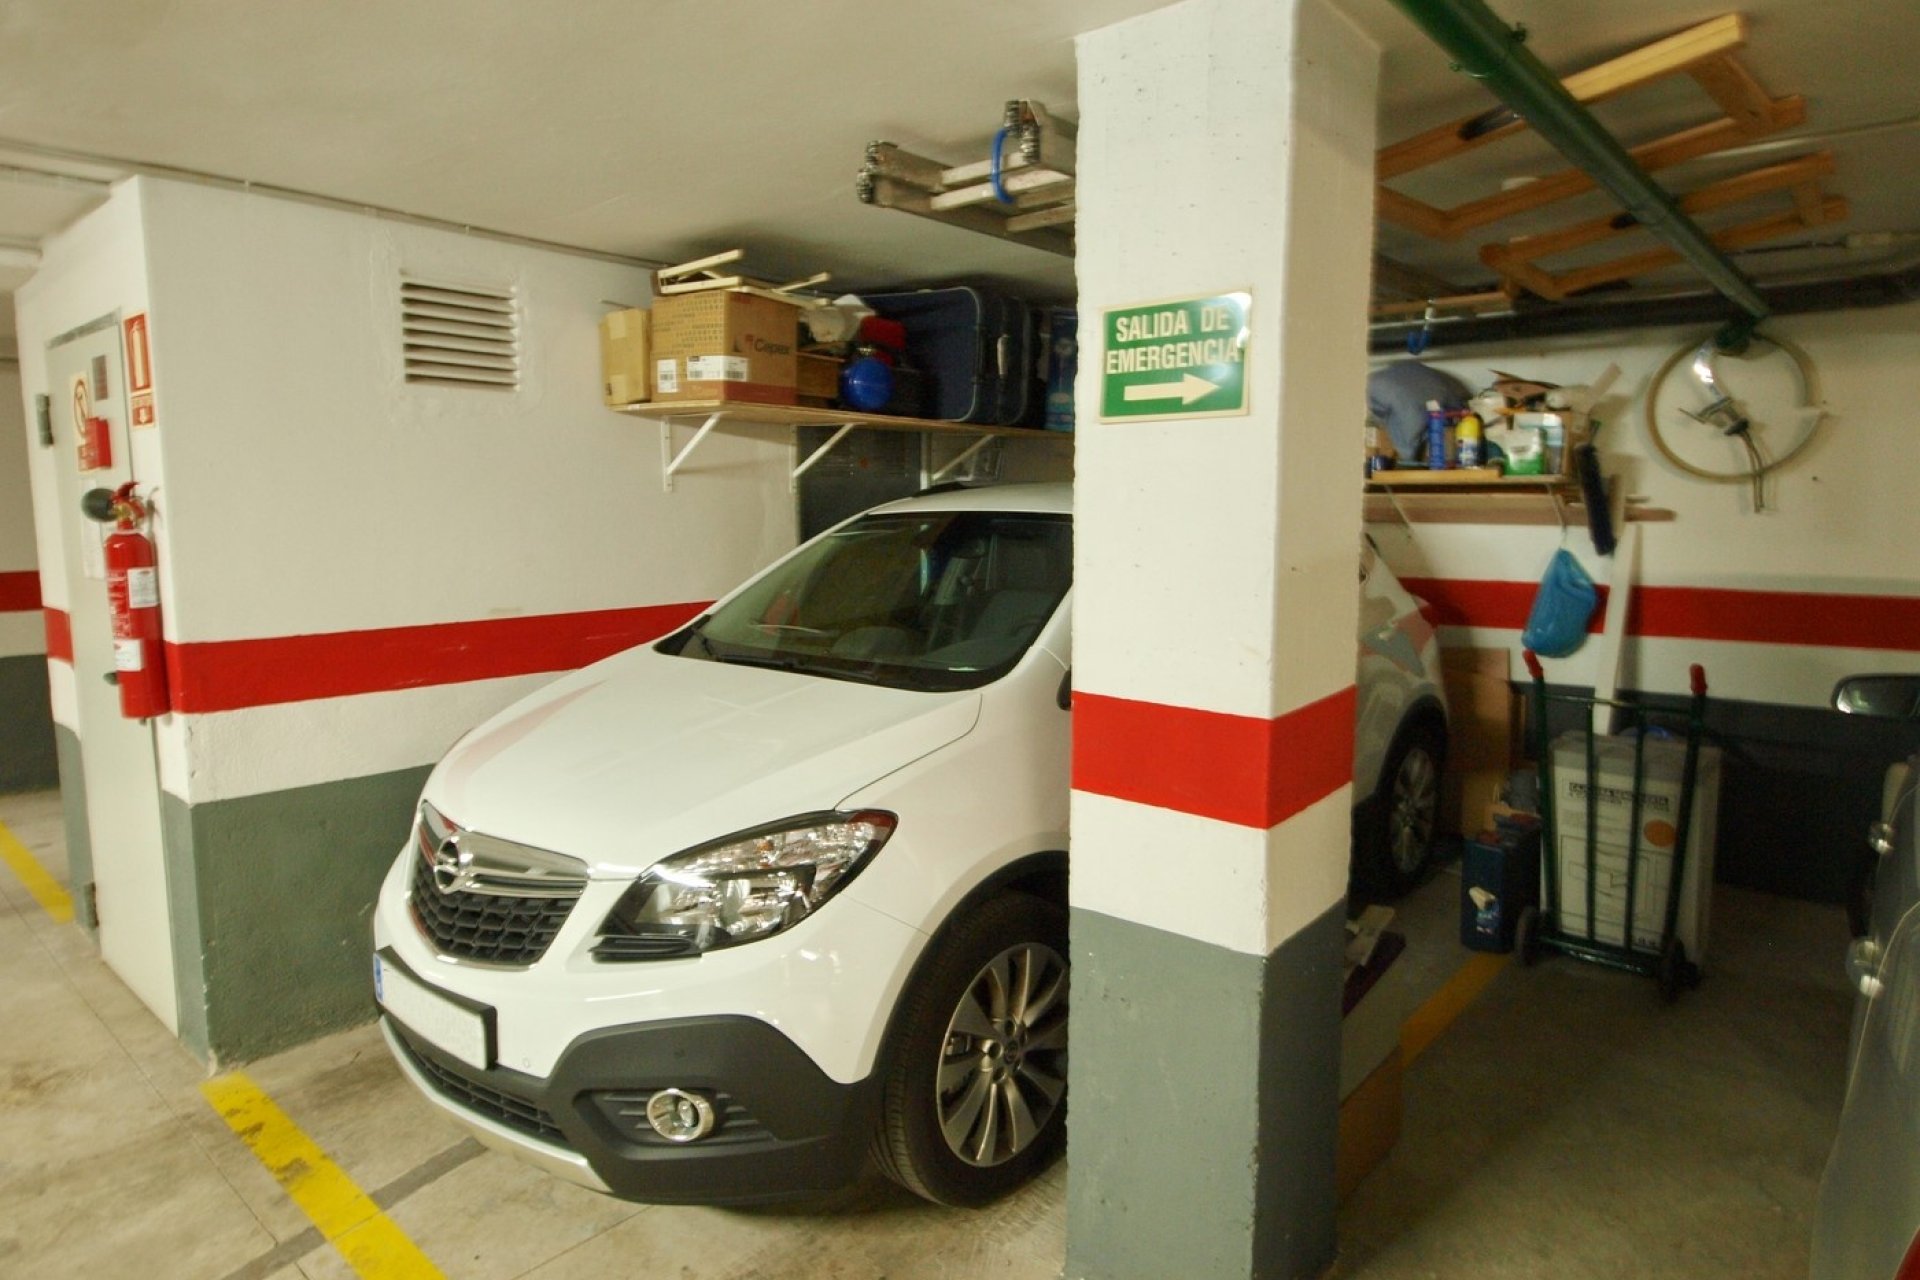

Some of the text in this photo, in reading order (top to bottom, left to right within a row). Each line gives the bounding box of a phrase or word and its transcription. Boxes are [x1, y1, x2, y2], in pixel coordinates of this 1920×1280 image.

[1116, 306, 1229, 342] SALIDA DE
[1106, 337, 1239, 374] EMERGENCIA
